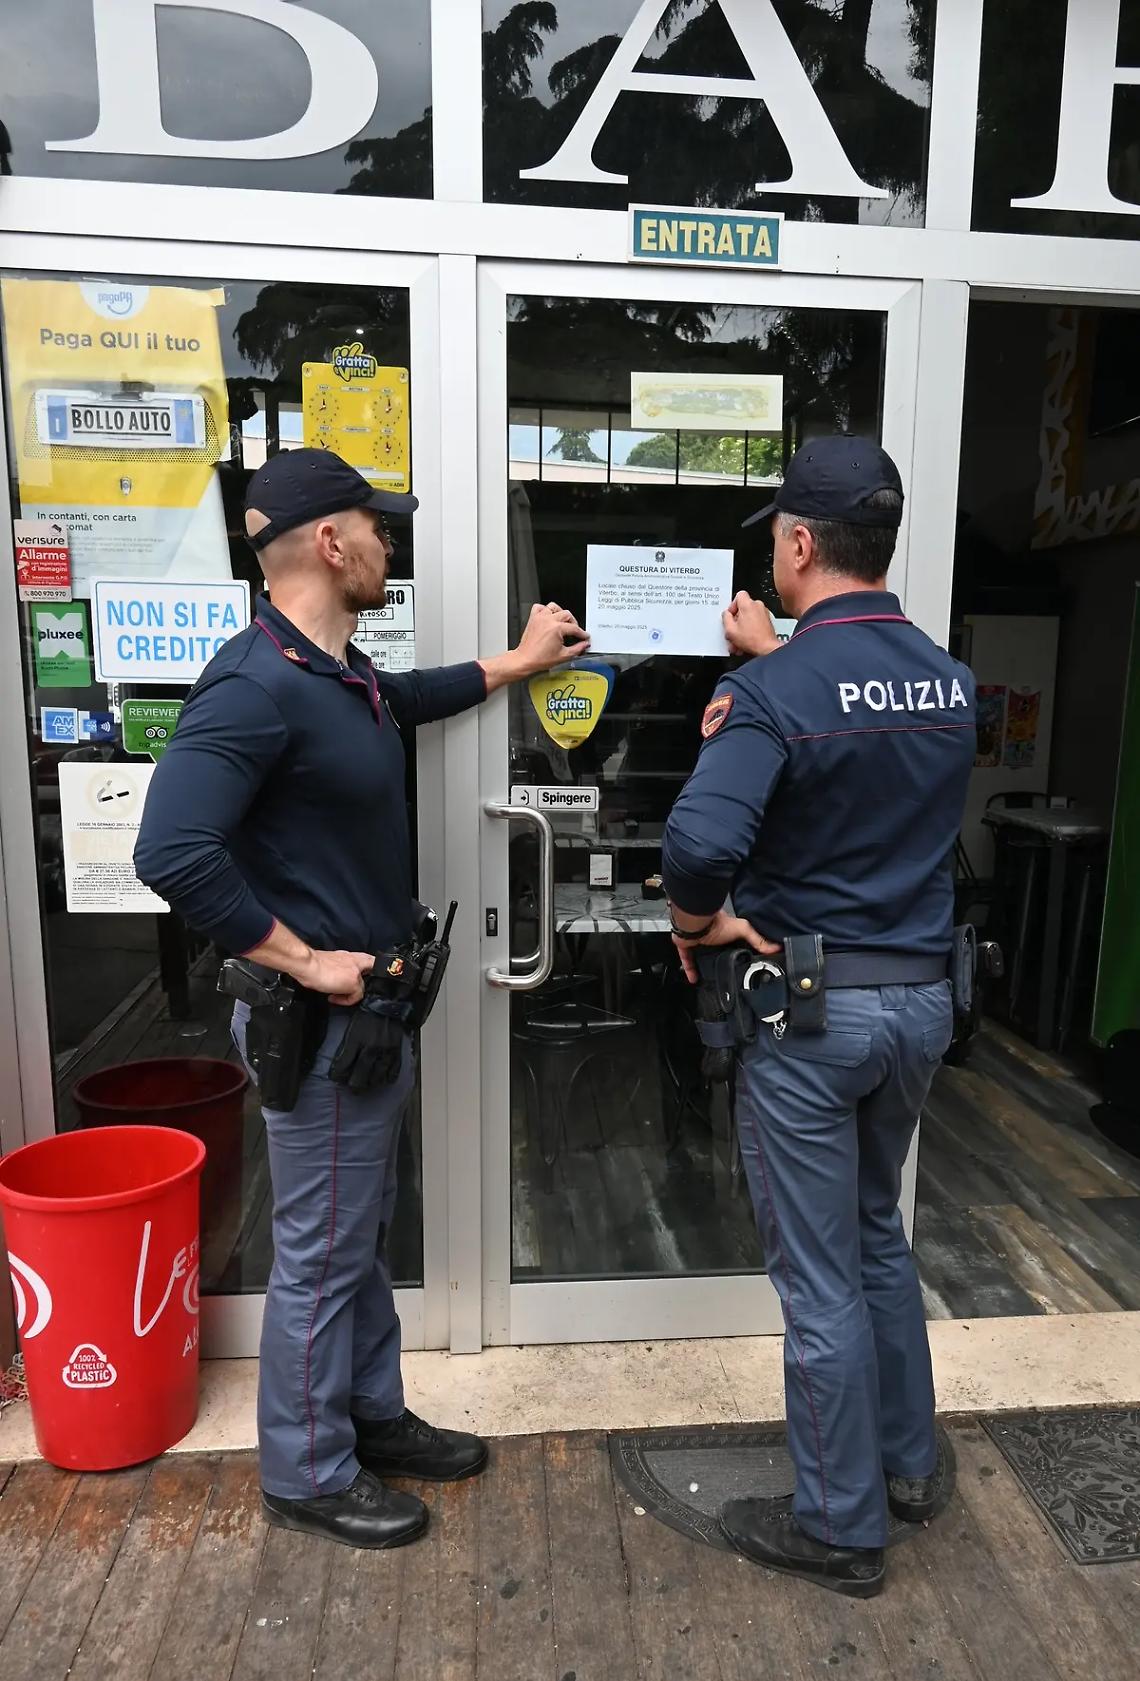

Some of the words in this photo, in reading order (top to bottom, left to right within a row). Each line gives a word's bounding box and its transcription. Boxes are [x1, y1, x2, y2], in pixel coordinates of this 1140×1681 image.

[640, 218, 773, 258] ENTRATA
[40, 328, 92, 349] Paga
[100, 331, 139, 349] QUI
[146, 332, 158, 350] il
[165, 334, 201, 351] tuo
[335, 355, 370, 368] Gratta
[72, 409, 124, 430] BOLLO
[129, 411, 171, 432] AUTO
[37, 512, 47, 520] In
[49, 512, 90, 522] contanti,
[112, 514, 137, 522] carta
[17, 536, 65, 546] verisure
[19, 549, 67, 561] Allarme
[619, 565, 658, 573] QUESTURA
[106, 600, 164, 627] NON
[174, 602, 196, 628] SI
[207, 603, 238, 629] FA
[38, 628, 84, 642] pluxee
[374, 632, 407, 640] POMERIGGIO
[838, 678, 968, 713] POLIZIA
[548, 698, 586, 709] Gratta
[52, 715, 75, 726] AM
[55, 725, 75, 736] EX
[542, 791, 591, 806] Spingere
[79, 1354, 96, 1362] 100%
[73, 1362, 105, 1370] RECYCLED
